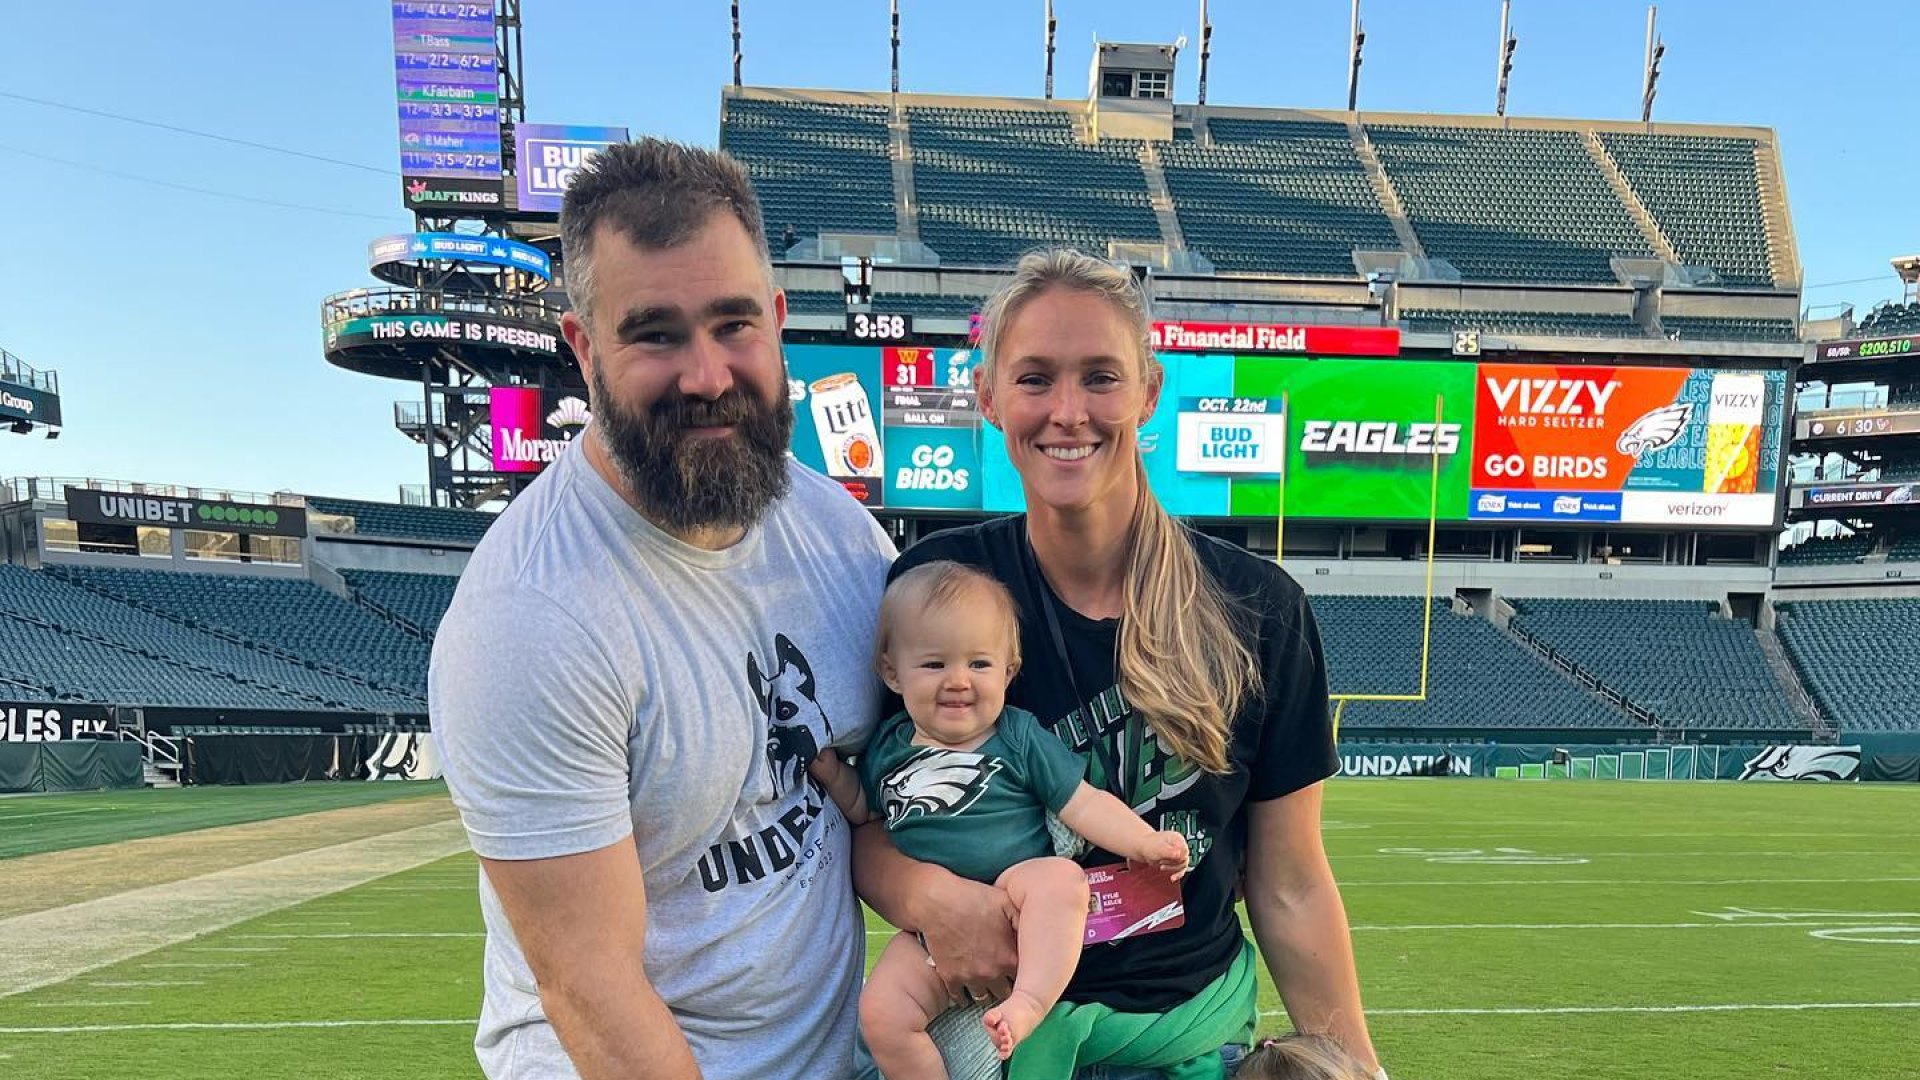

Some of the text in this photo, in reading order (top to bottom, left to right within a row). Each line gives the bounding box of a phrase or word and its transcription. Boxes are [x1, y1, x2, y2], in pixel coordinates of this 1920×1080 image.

[428, 53, 449, 66] 2/2
[411, 191, 499, 203] DRAFTKINGS
[433, 242, 485, 254] BUD LIGHT
[370, 321, 405, 339] THIS
[410, 321, 460, 339] GAME
[465, 323, 482, 340] IS
[854, 314, 905, 338] 3:58
[1163, 325, 1254, 349] Financial
[1257, 328, 1307, 350] Field
[1859, 339, 1911, 357] $200,510
[896, 364, 917, 385] 31
[947, 366, 970, 387] 34
[3, 392, 33, 414] Group
[1486, 378, 1620, 415] VIZZY
[1715, 393, 1759, 408] VIZZY
[1198, 400, 1267, 413] OCT. 22nd
[903, 412, 945, 424] BALL ON
[1498, 416, 1605, 429] HARD SELTZER
[1855, 419, 1873, 433] 30
[1210, 427, 1251, 442] BUD
[1836, 420, 1846, 434] 6
[1300, 420, 1461, 454] EAGLES
[911, 445, 954, 467] GO
[1201, 443, 1259, 459] LIGHT
[1484, 454, 1525, 478] GO
[1532, 456, 1608, 479] BIRDS
[895, 468, 969, 491] BIRDS
[1812, 490, 1881, 503] CURRENT DRIVE
[100, 496, 193, 523] UNIBET
[1667, 501, 1724, 516] verizon
[1088, 929, 1096, 938] D
